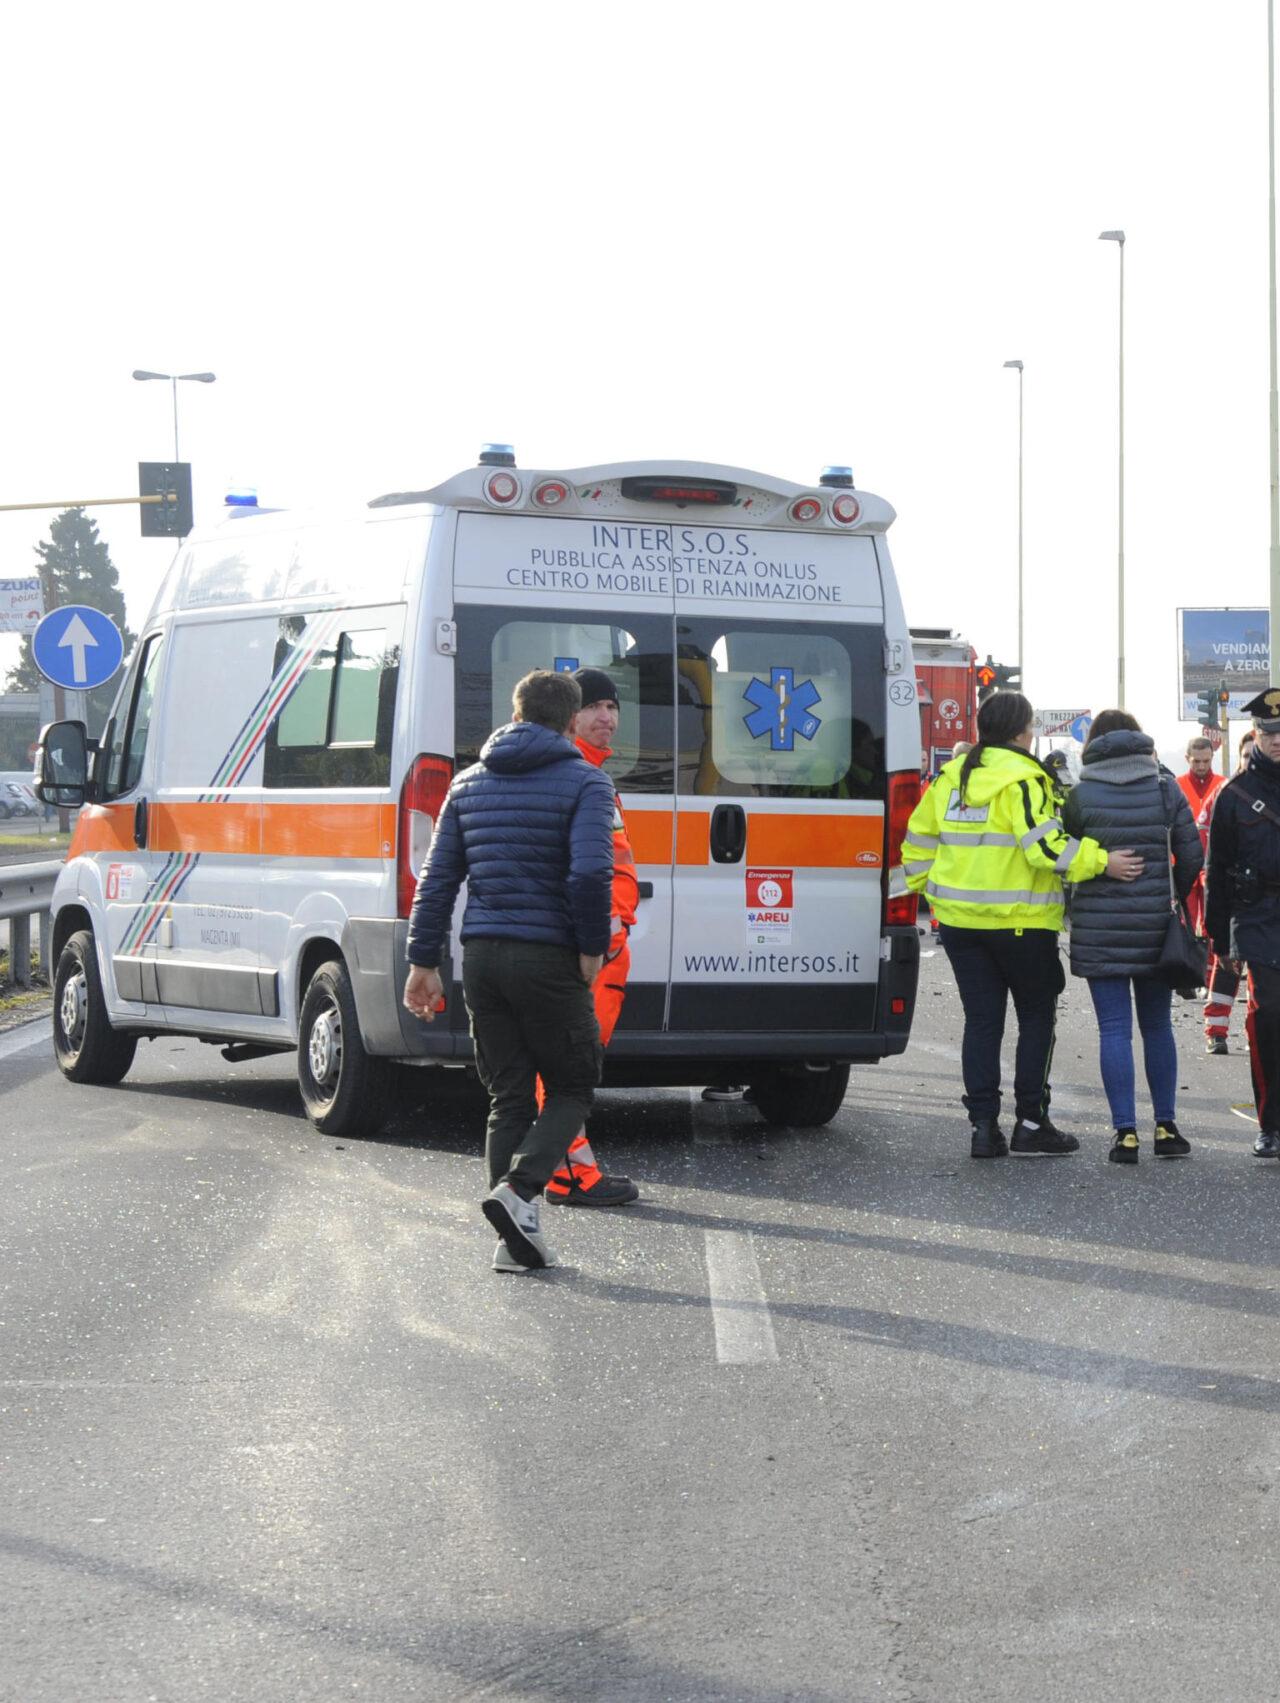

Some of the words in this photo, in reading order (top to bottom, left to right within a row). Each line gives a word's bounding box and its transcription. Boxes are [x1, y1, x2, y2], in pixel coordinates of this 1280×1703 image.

[593, 525, 671, 551] INTER
[681, 530, 757, 556] S.O.S.
[531, 549, 625, 570] PUBBLICA
[632, 555, 748, 577] ASSISTENZA
[754, 561, 817, 581] ONLUS
[506, 568, 589, 589] CENTRO
[597, 574, 669, 593] MOBILE
[676, 578, 695, 595] DI
[703, 579, 842, 602] RIANIMAZIONE
[1225, 659, 1233, 671] A
[1237, 659, 1269, 671] ZERO
[892, 685, 913, 701] 32
[765, 888, 778, 898] 112
[756, 912, 790, 923] AREU
[684, 951, 860, 973] www.intersos.it
